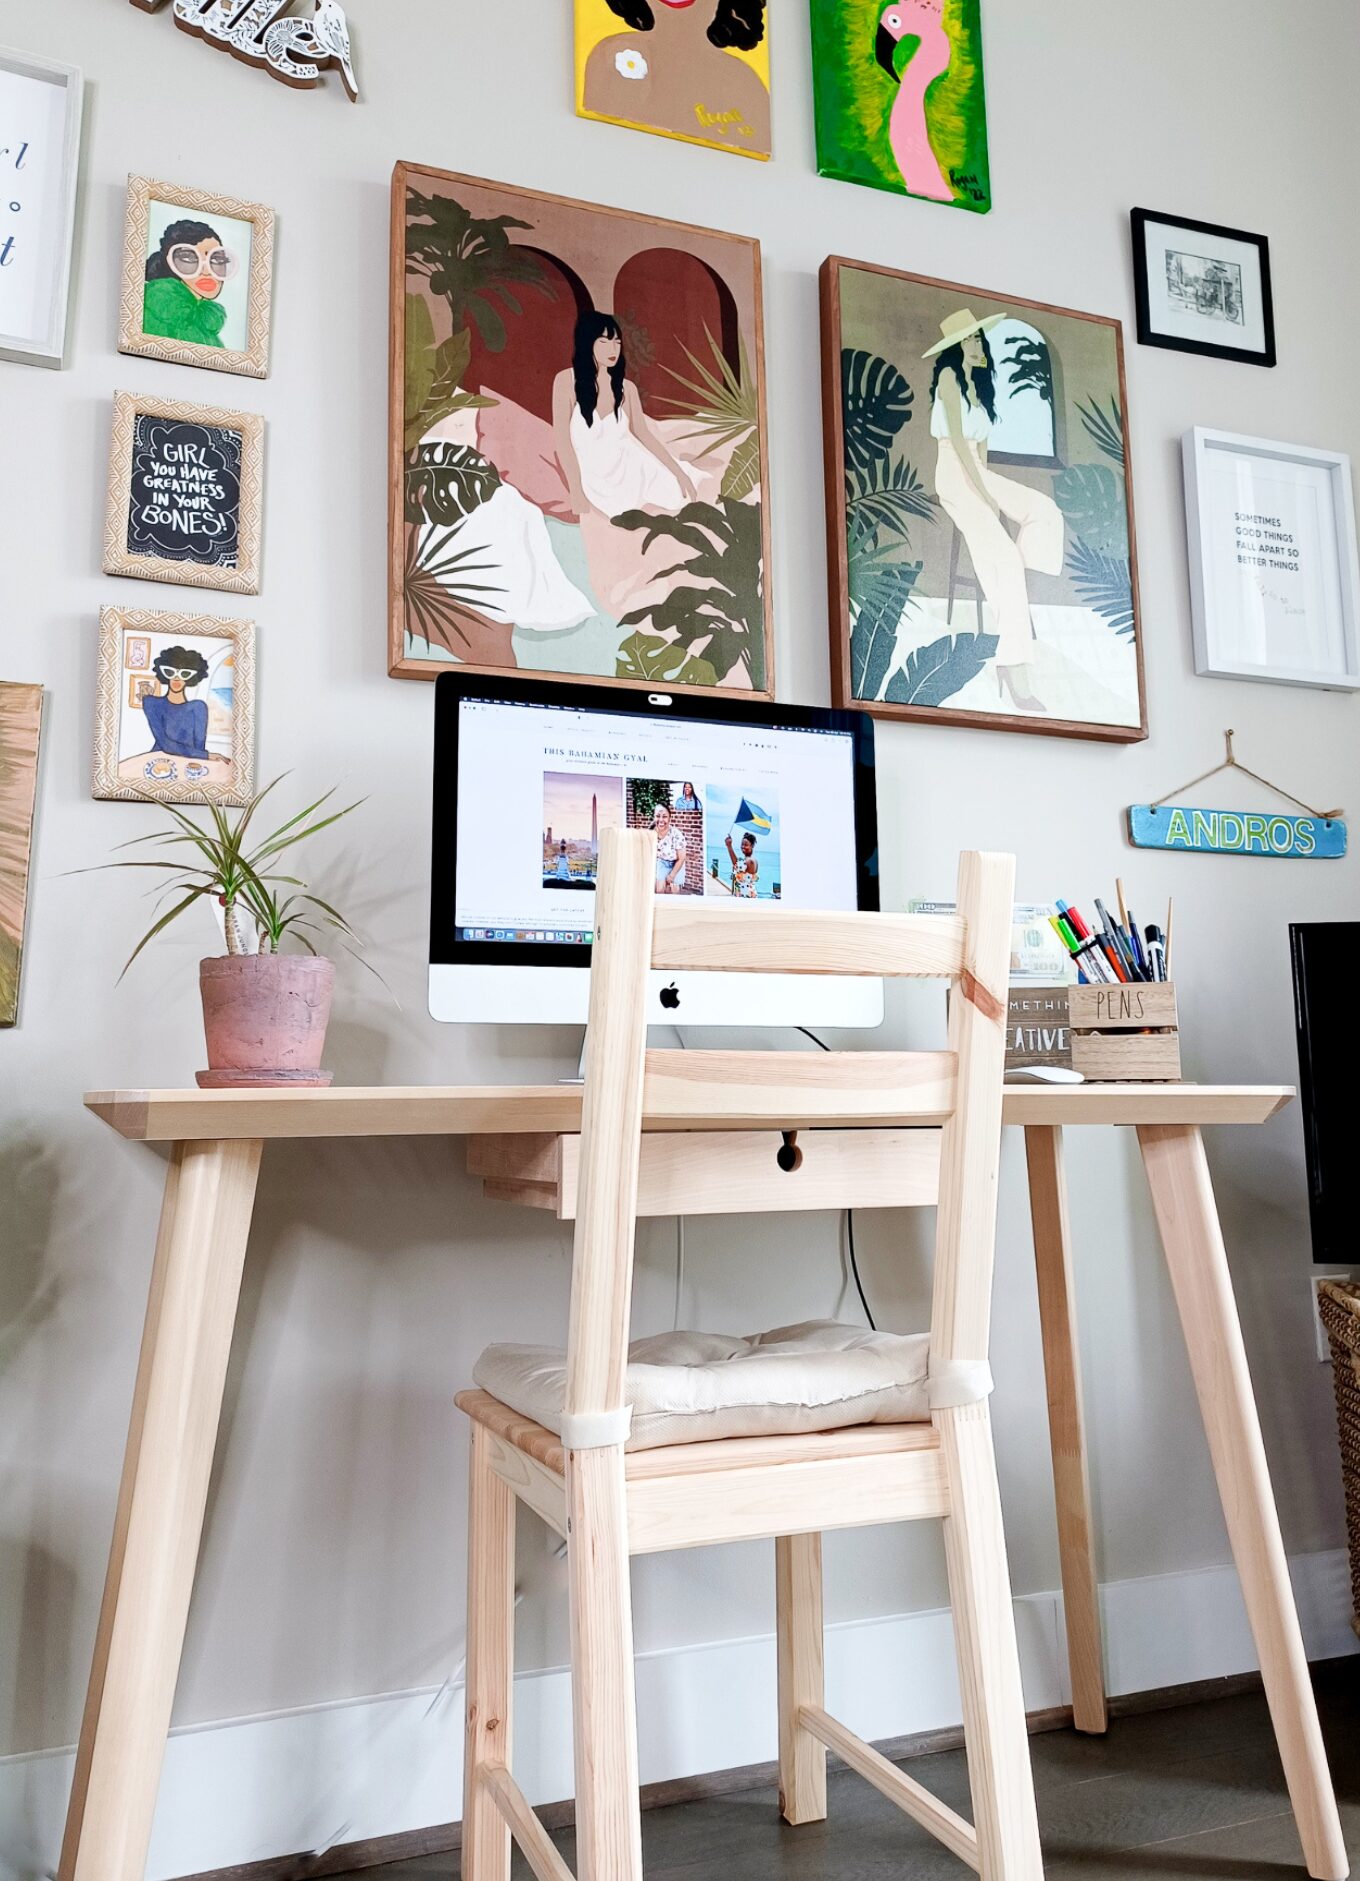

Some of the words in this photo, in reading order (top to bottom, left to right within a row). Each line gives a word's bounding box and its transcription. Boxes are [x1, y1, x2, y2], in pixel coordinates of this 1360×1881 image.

[163, 443, 210, 469] GIRL
[150, 461, 177, 476] YOU
[179, 464, 218, 482] HAVE
[143, 475, 226, 500] GREATNESS
[152, 491, 170, 506] IN
[173, 494, 216, 512] YOUR
[141, 505, 227, 535] BONES!
[1234, 512, 1281, 527] SOMETIMES
[1236, 526, 1261, 538] GOOD
[1264, 531, 1293, 543] THINGS
[1236, 540, 1256, 552] FALL
[1259, 544, 1285, 555] APART
[1287, 548, 1299, 558] SO
[1237, 555, 1267, 567] BETTER
[1269, 560, 1299, 572] THINGS
[544, 747, 564, 756] THIS
[1165, 809, 1316, 854] ANDROS
[1097, 990, 1145, 1020] PENS
